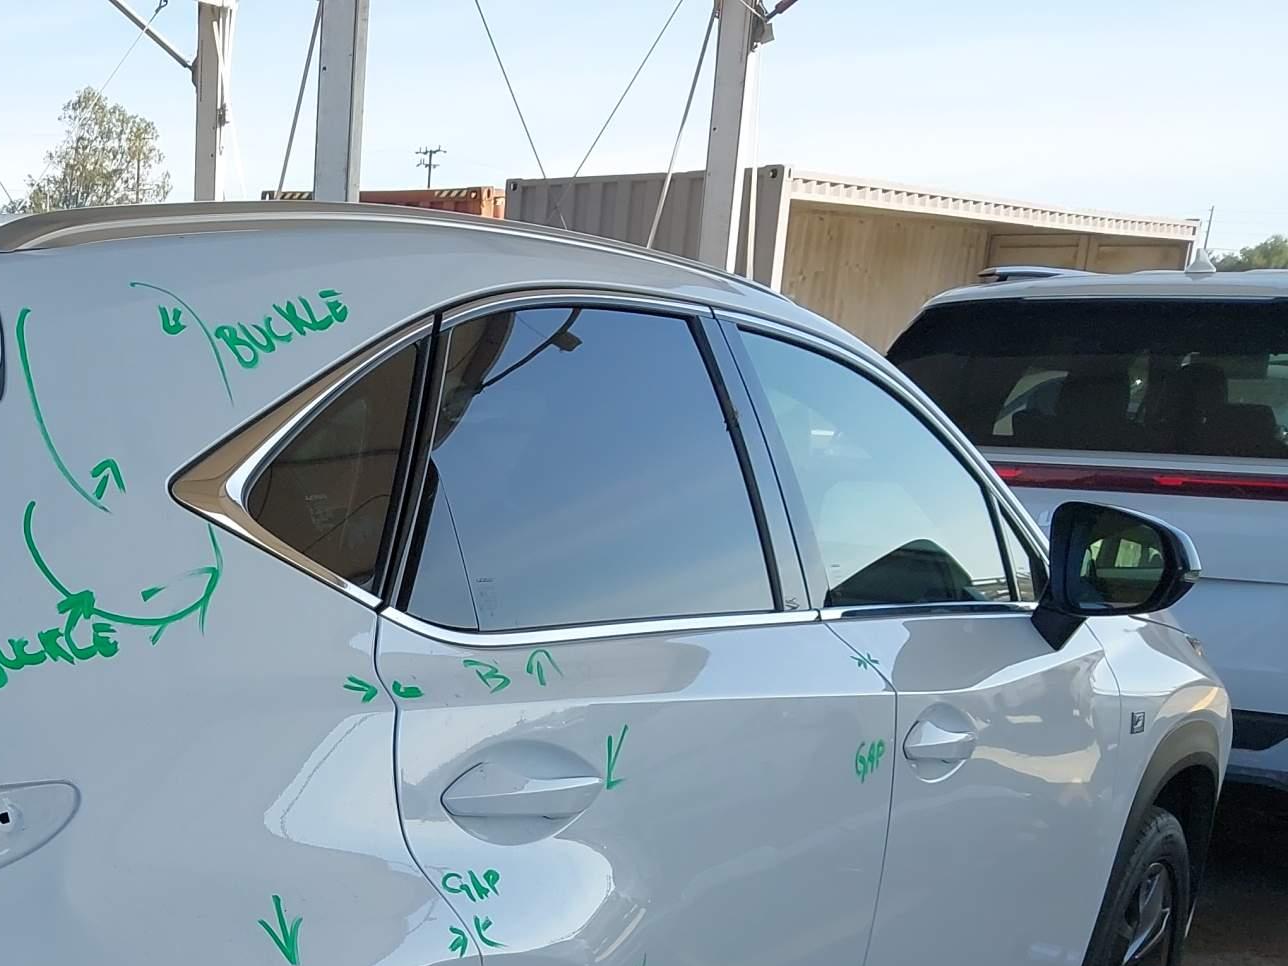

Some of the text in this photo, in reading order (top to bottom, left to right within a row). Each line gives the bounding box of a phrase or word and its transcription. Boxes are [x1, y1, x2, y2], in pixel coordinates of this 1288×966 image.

[214, 289, 349, 369] BUCKLE
[855, 739, 886, 783] GAP
[441, 869, 501, 902] GAP
